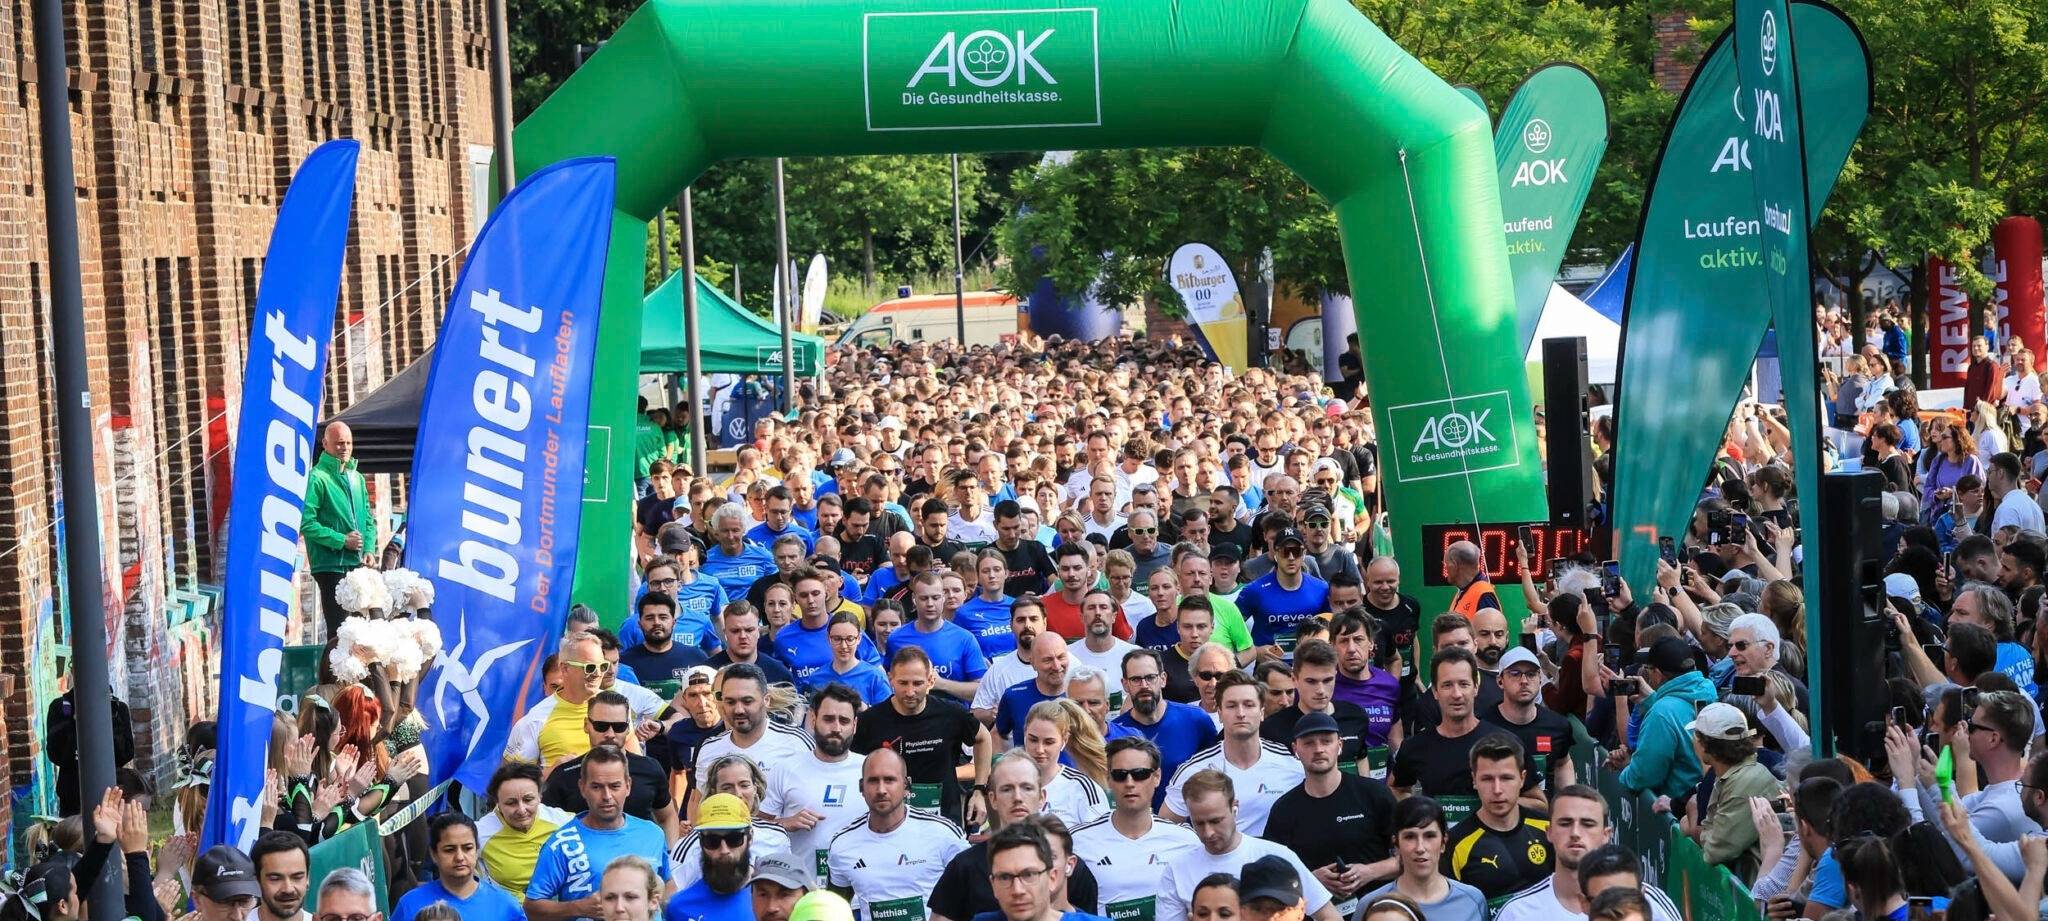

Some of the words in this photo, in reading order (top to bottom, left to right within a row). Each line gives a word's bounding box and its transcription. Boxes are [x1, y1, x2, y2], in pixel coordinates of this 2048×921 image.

[906, 29, 1058, 88] AOK
[902, 91, 925, 105] Die
[929, 90, 1062, 105] Gesundheitskasse.
[1511, 158, 1568, 188] AOK
[1504, 216, 1553, 233] aufend
[1684, 216, 1760, 239] Laufen
[1700, 246, 1763, 269] aktiv.
[1177, 272, 1226, 289] Bitburger
[1939, 265, 1969, 374] REWE
[546, 310, 575, 425] Laufladen
[1413, 408, 1496, 453] AOK
[438, 288, 543, 603] bunert
[1411, 454, 1423, 463] Die
[535, 430, 561, 567] Dortmunder
[239, 309, 317, 712] bunert
[531, 574, 550, 613] Der
[981, 624, 1012, 637] adess
[2016, 658, 2032, 671] THE
[1442, 804, 1471, 812] ndreas
[550, 825, 592, 893] Nach
[1530, 846, 1545, 859] BVB
[873, 908, 908, 919] Matthias
[1110, 908, 1141, 920] Michel
